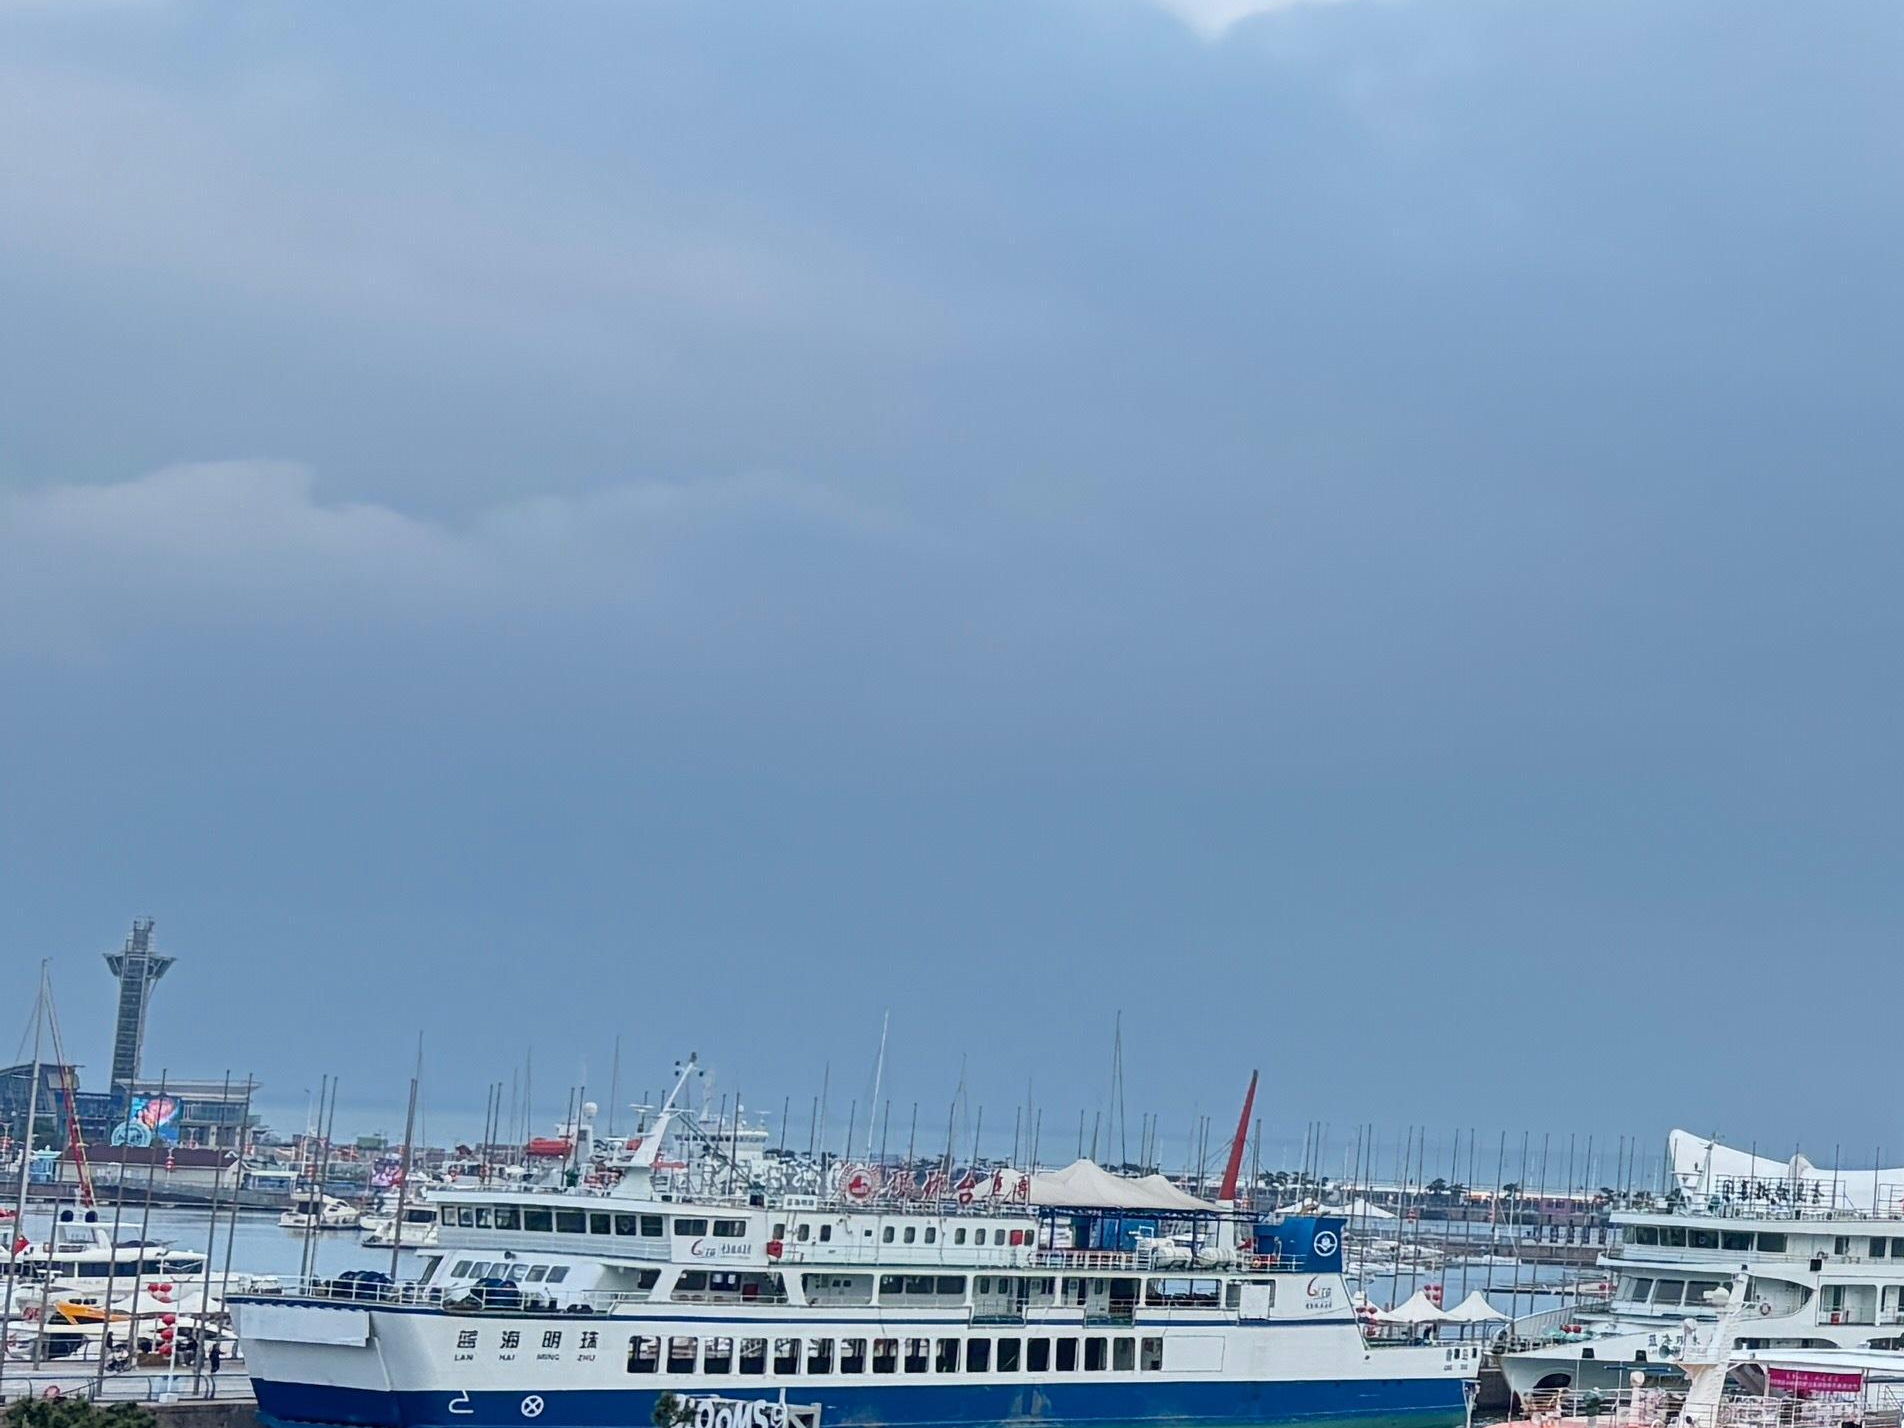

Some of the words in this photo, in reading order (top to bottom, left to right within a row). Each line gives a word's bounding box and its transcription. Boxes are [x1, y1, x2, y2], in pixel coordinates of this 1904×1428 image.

[454, 1353, 474, 1362] LAN
[498, 1353, 516, 1362] HAI
[576, 1353, 596, 1362] ZHU
